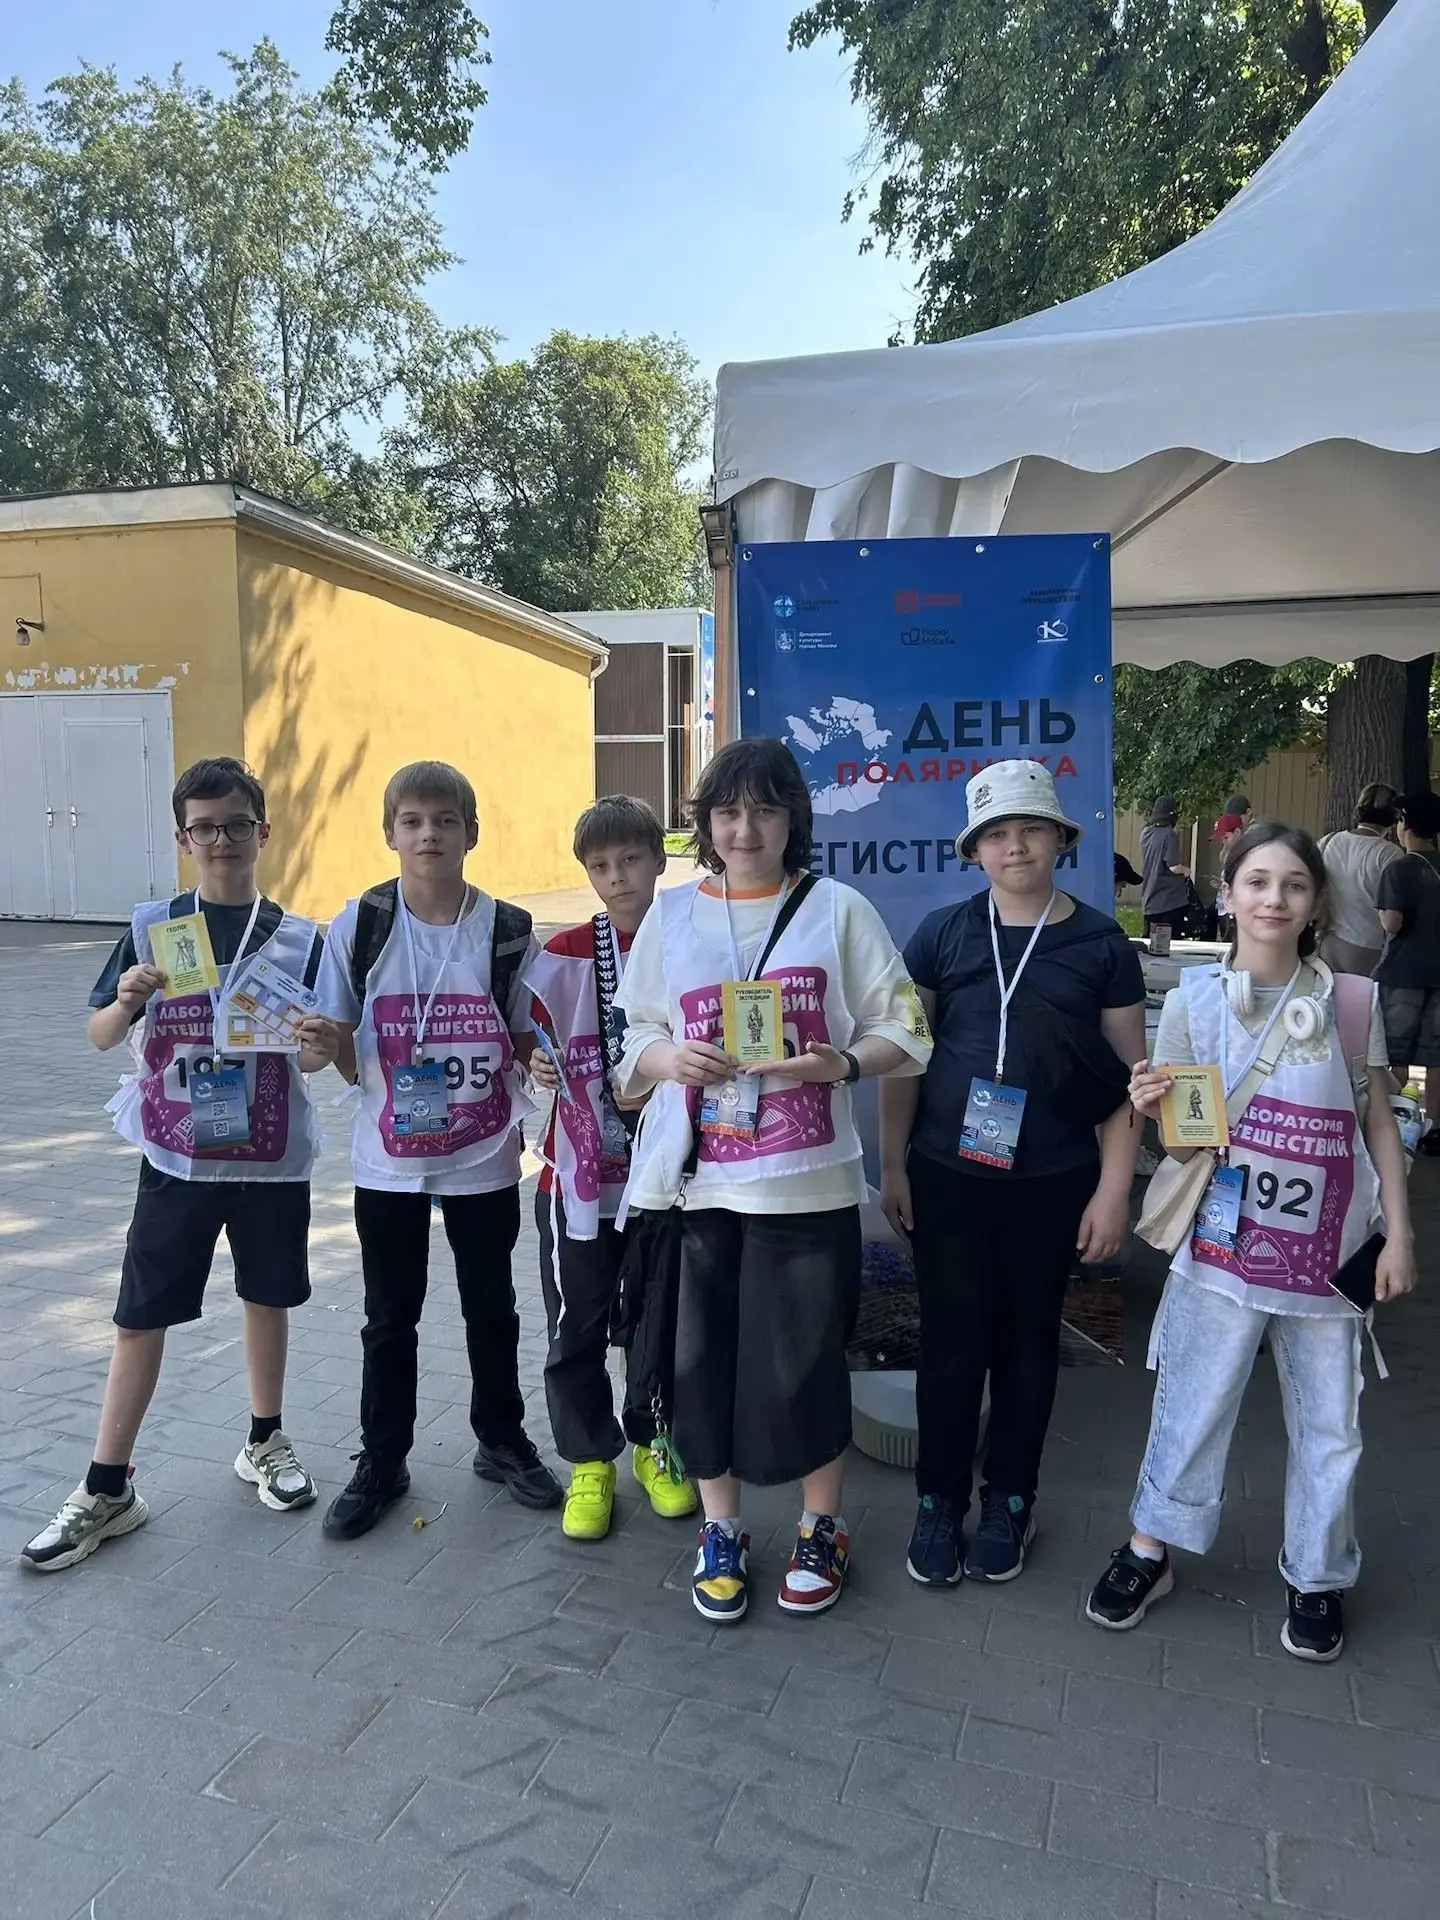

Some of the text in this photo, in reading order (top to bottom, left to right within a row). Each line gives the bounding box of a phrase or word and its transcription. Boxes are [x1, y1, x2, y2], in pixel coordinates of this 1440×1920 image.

[903, 698, 1076, 754] ДЕНЬ
[837, 755, 1078, 785] ПОЛЯРНА
[159, 1004, 214, 1020] ЛАБОР
[381, 1019, 505, 1037] ПУТЕШЕСТВ
[569, 1045, 602, 1061] ЛАБ
[423, 1056, 492, 1090] 95
[1236, 1164, 1313, 1218] 192
